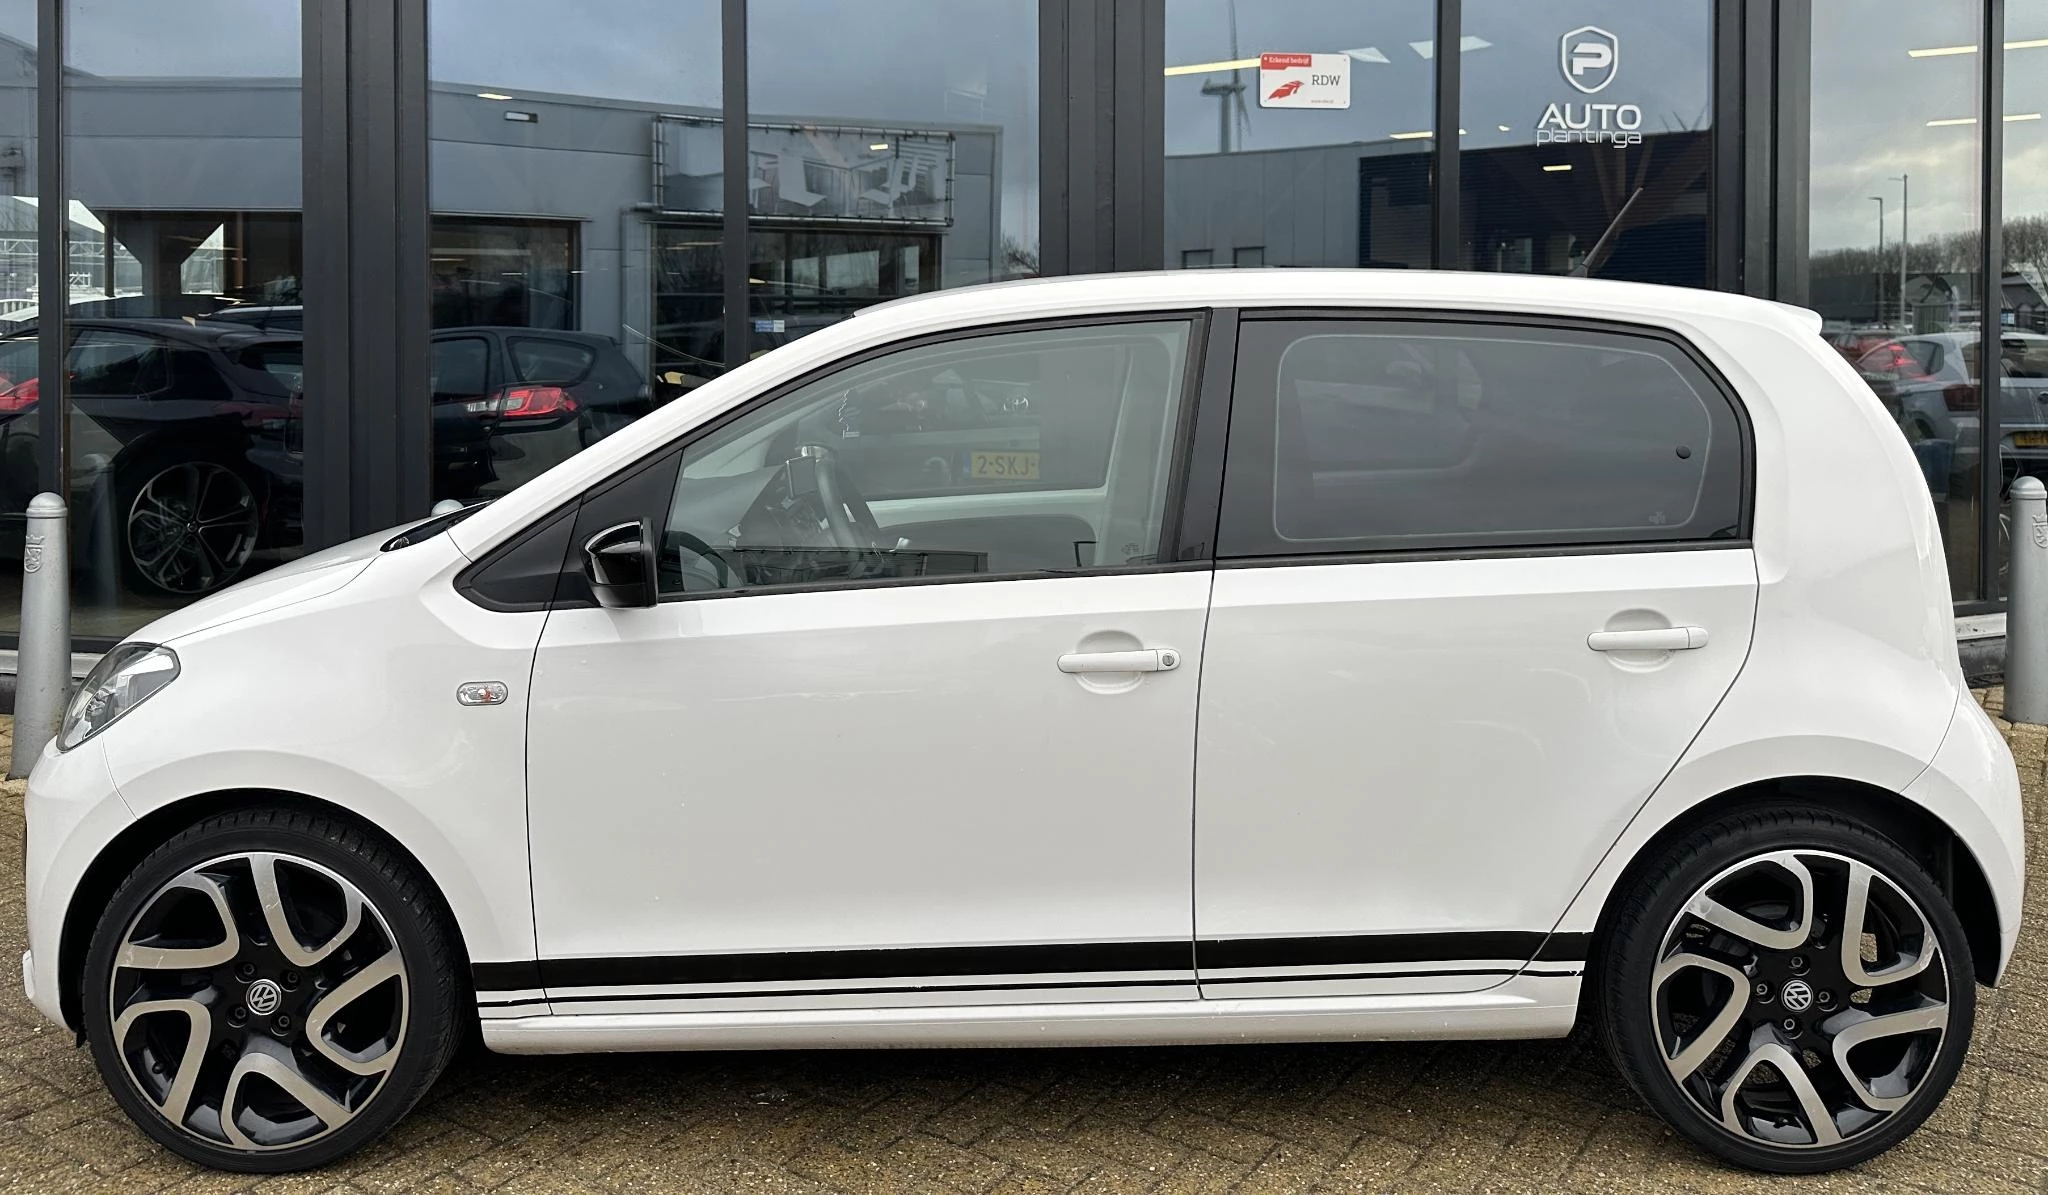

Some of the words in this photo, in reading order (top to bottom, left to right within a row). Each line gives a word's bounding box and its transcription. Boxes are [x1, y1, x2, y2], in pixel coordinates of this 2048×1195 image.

[1311, 74, 1341, 86] RDW
[1537, 103, 1642, 130] AUTO
[1536, 127, 1642, 148] plantinga
